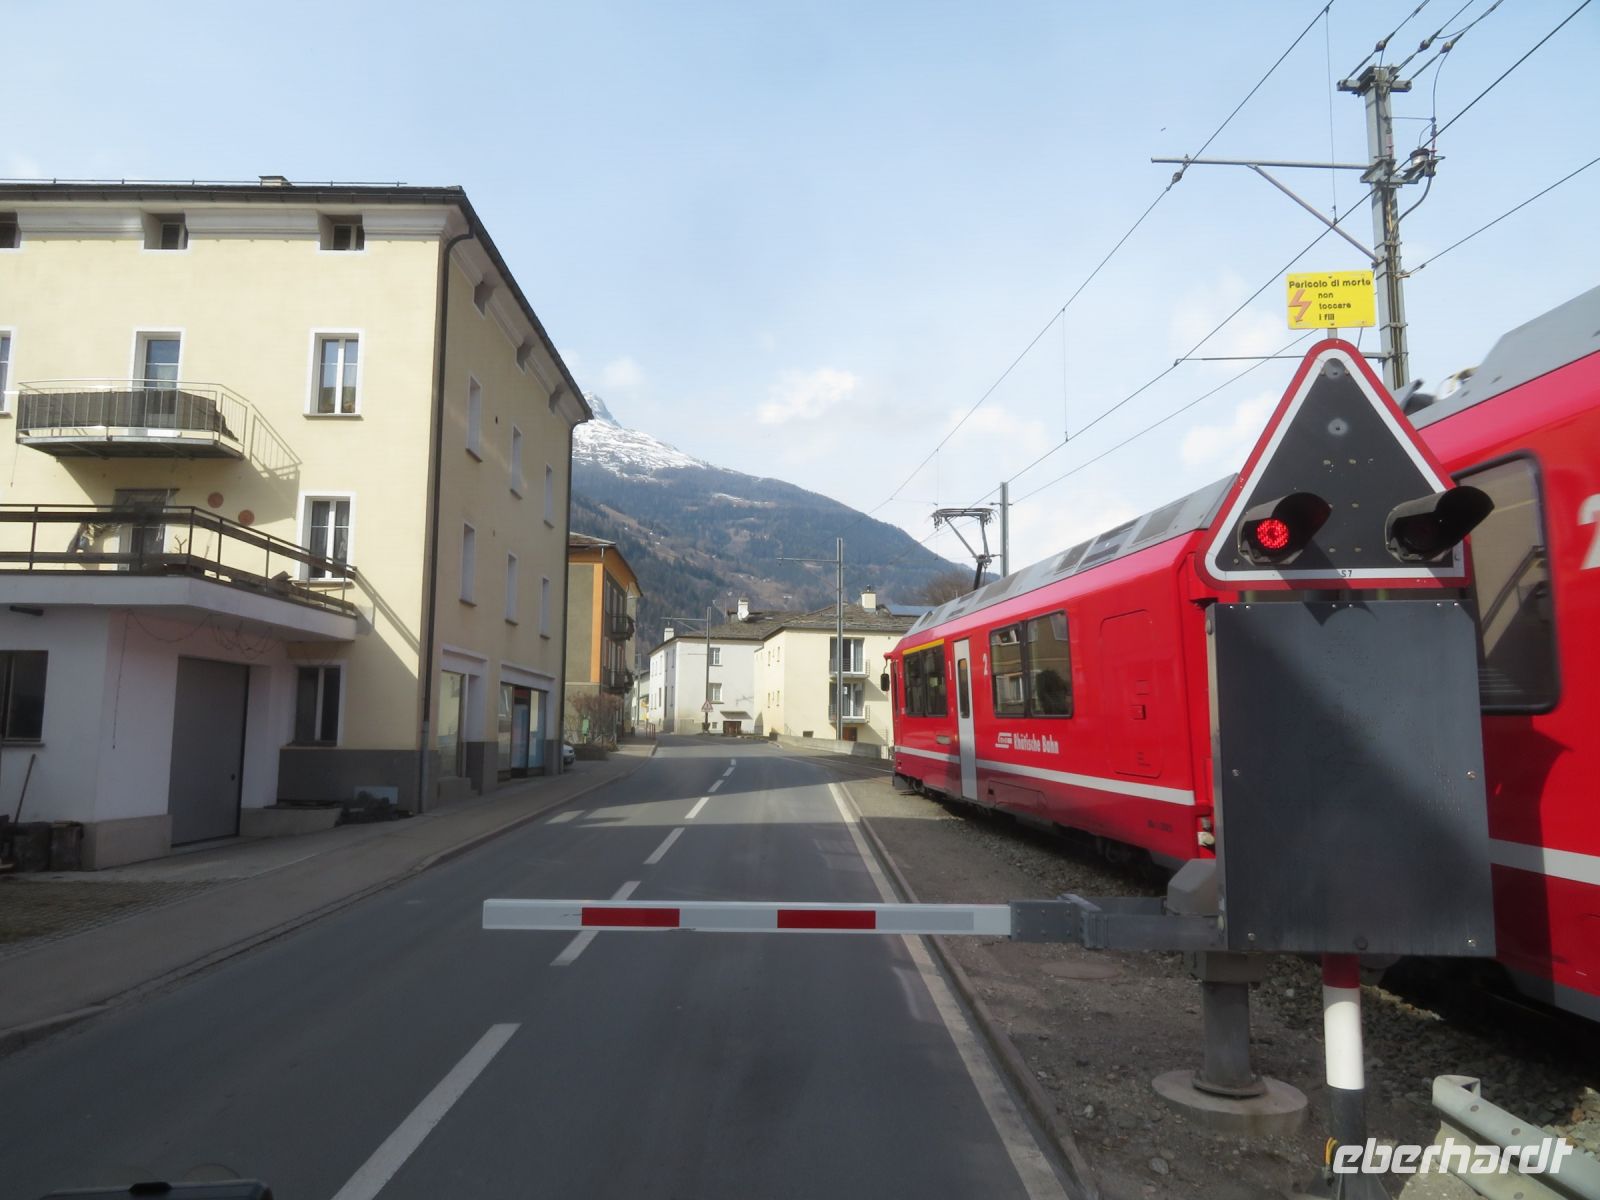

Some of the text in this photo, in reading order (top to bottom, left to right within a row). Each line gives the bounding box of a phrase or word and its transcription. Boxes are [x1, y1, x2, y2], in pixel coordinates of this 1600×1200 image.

[1289, 278, 1371, 289] Pericolo di morte
[1041, 734, 1059, 754] Bahn
